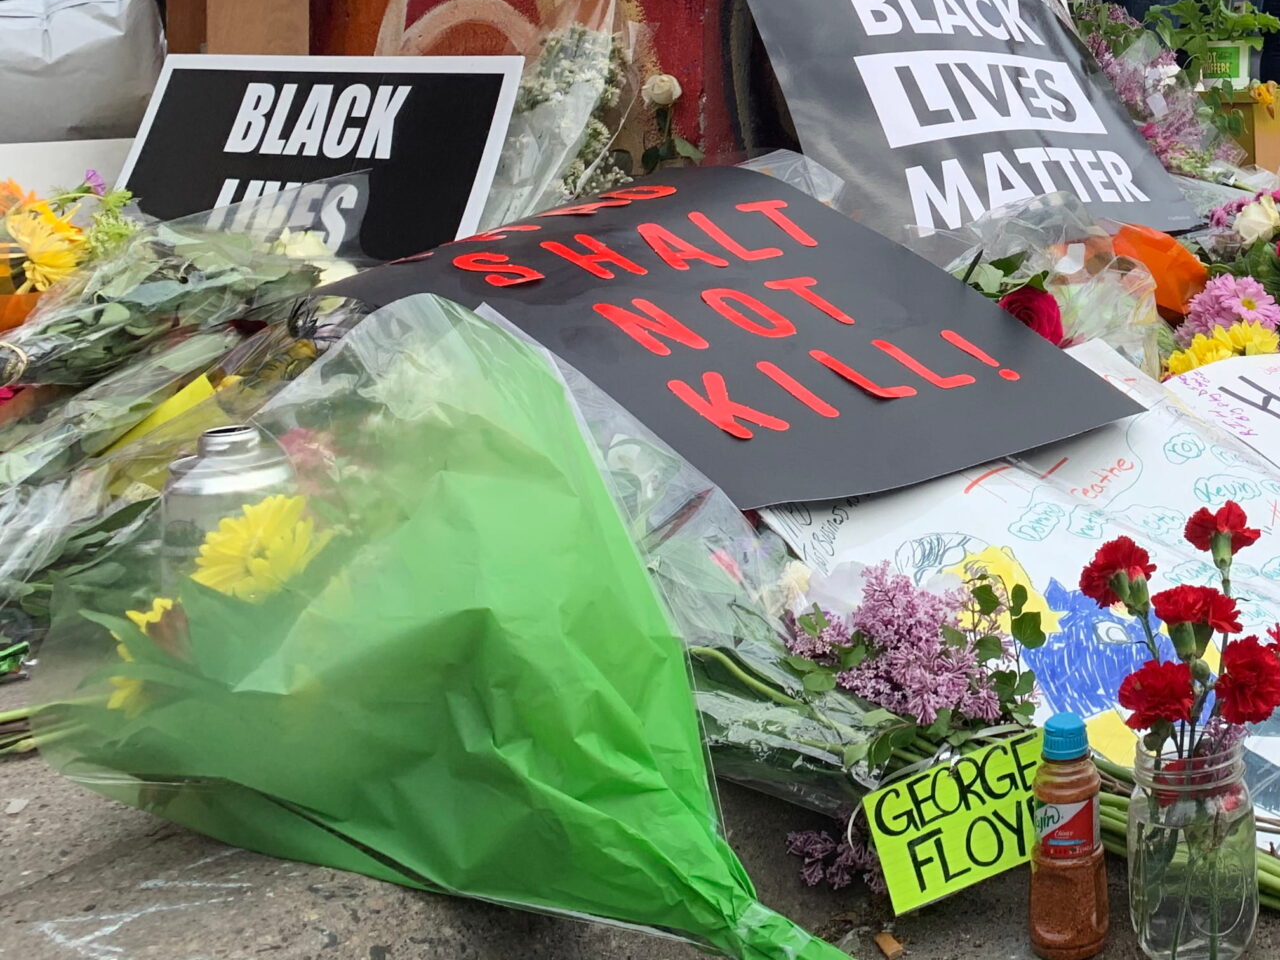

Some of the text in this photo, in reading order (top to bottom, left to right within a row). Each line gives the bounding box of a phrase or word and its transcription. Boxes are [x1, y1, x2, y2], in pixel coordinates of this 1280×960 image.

[223, 82, 412, 160] BLACK
[893, 61, 1078, 127] LIVES
[904, 147, 1152, 238] MATTER
[453, 199, 818, 287] SHALT
[592, 276, 855, 357] NOT
[667, 329, 1021, 440] KILL!
[874, 739, 1037, 838] GEORGE
[907, 796, 1040, 894] FLOY
